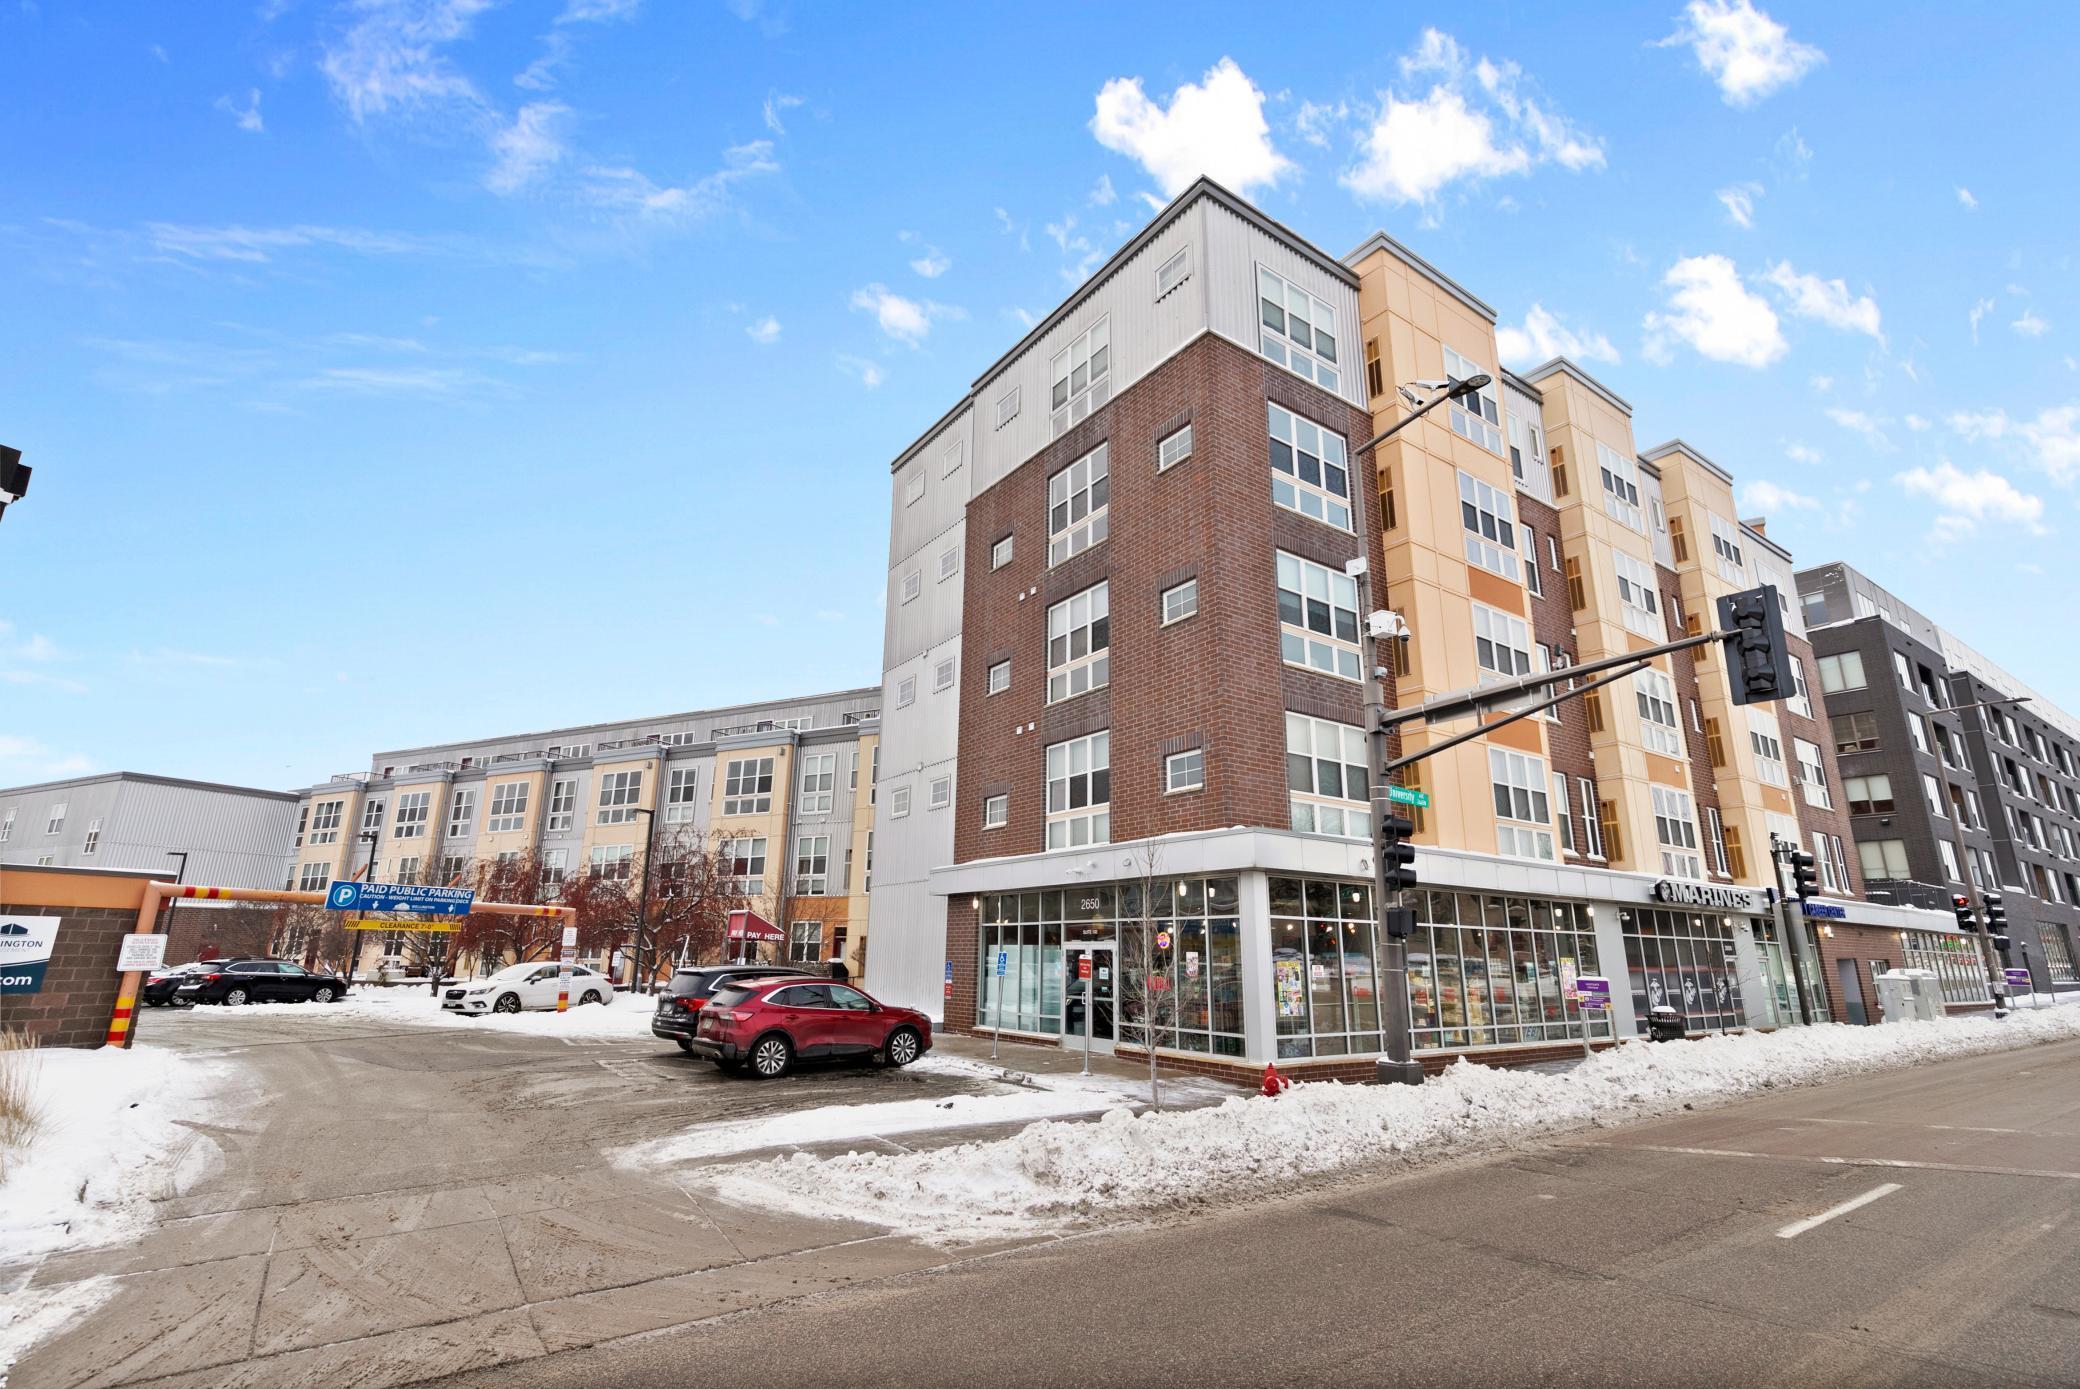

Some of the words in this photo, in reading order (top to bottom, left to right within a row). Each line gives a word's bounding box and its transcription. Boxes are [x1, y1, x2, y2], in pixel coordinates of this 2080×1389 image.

[338, 889, 352, 903] P
[361, 884, 387, 894] PAID
[389, 886, 428, 897] PUBLIC
[428, 888, 472, 899] PARKING
[1671, 884, 1752, 908] MARINES
[1081, 898, 1099, 909] 2650
[380, 922, 419, 930] CLEARANCE
[747, 931, 761, 939] PAY
[764, 933, 785, 941] HERE
